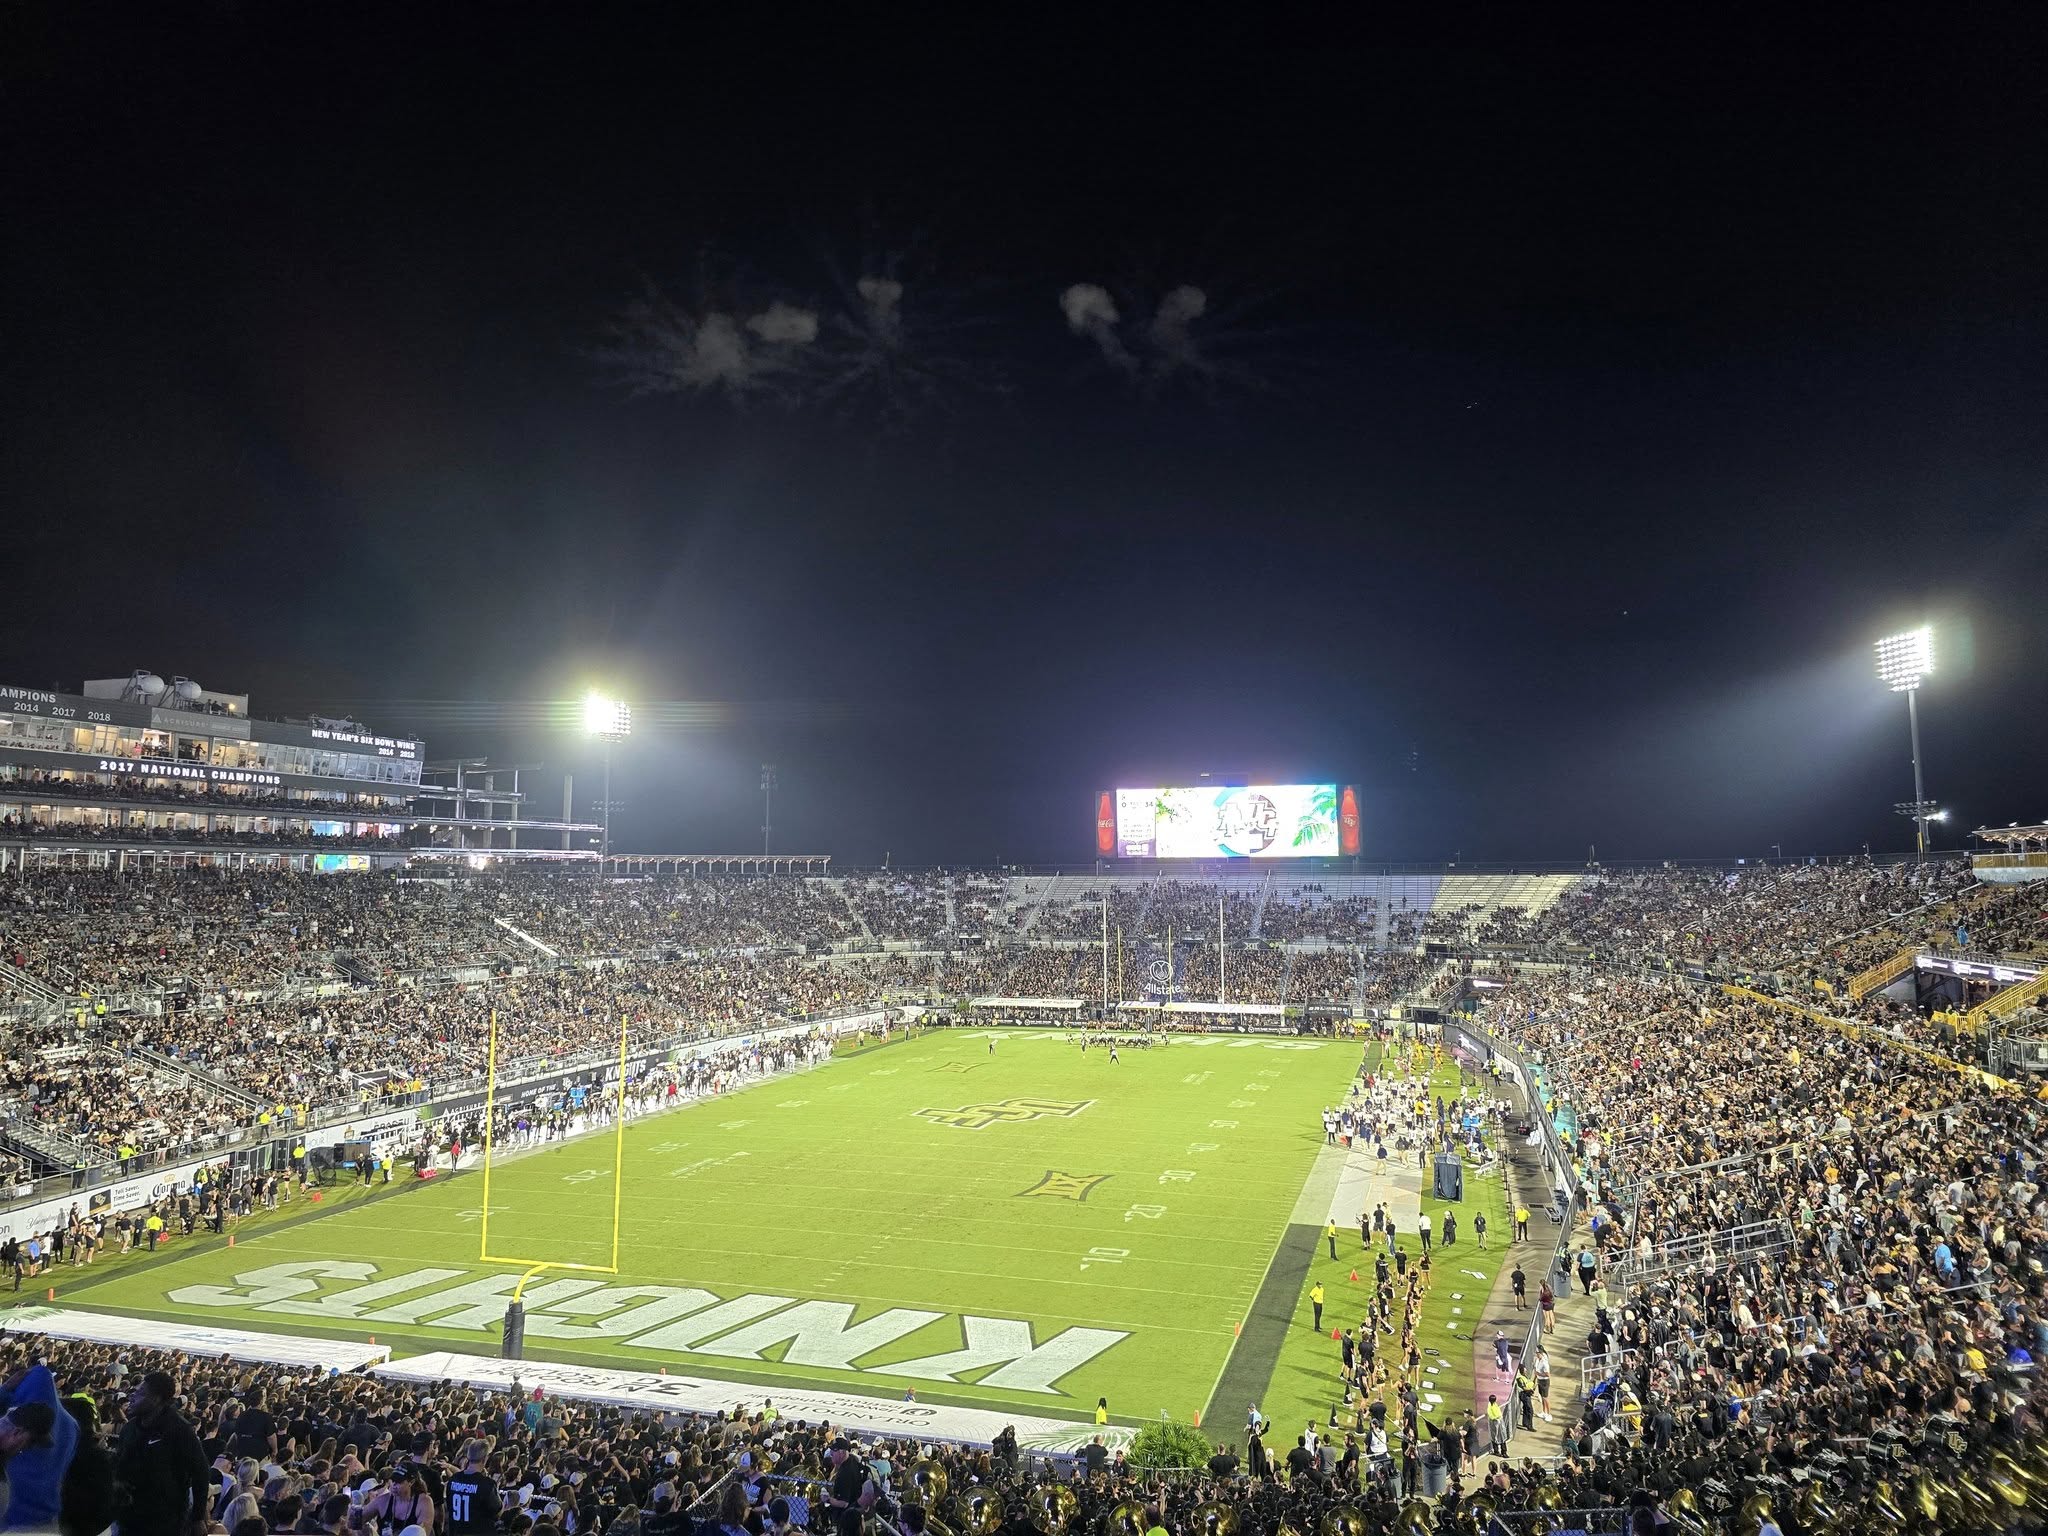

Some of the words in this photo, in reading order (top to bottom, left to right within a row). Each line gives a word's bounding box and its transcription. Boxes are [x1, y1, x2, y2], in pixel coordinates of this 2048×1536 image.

[14, 702, 39, 712] 2014
[52, 707, 75, 717] 2017
[88, 711, 111, 721] 2018
[312, 729, 330, 738] NEW
[332, 732, 359, 743] YEAR'S
[360, 736, 373, 745] SIX
[375, 738, 395, 748] BOWL
[397, 741, 415, 750] WINS
[100, 761, 134, 772] 2017
[141, 764, 206, 779] NATIONAL
[211, 771, 281, 784] CHAMPIONS
[1144, 982, 1181, 995] Allstate
[1124, 1204, 1168, 1219] 20
[1082, 1247, 1130, 1263] 10
[169, 1261, 1129, 1394] KNIGHTS
[743, 1393, 837, 1405] Orthopedic
[835, 1397, 904, 1409] Institute
[839, 1401, 897, 1413] Jewett
[812, 1407, 931, 1427] ORLANDO
[451, 1481, 478, 1494] THOMPSON
[452, 1494, 470, 1522] 91
